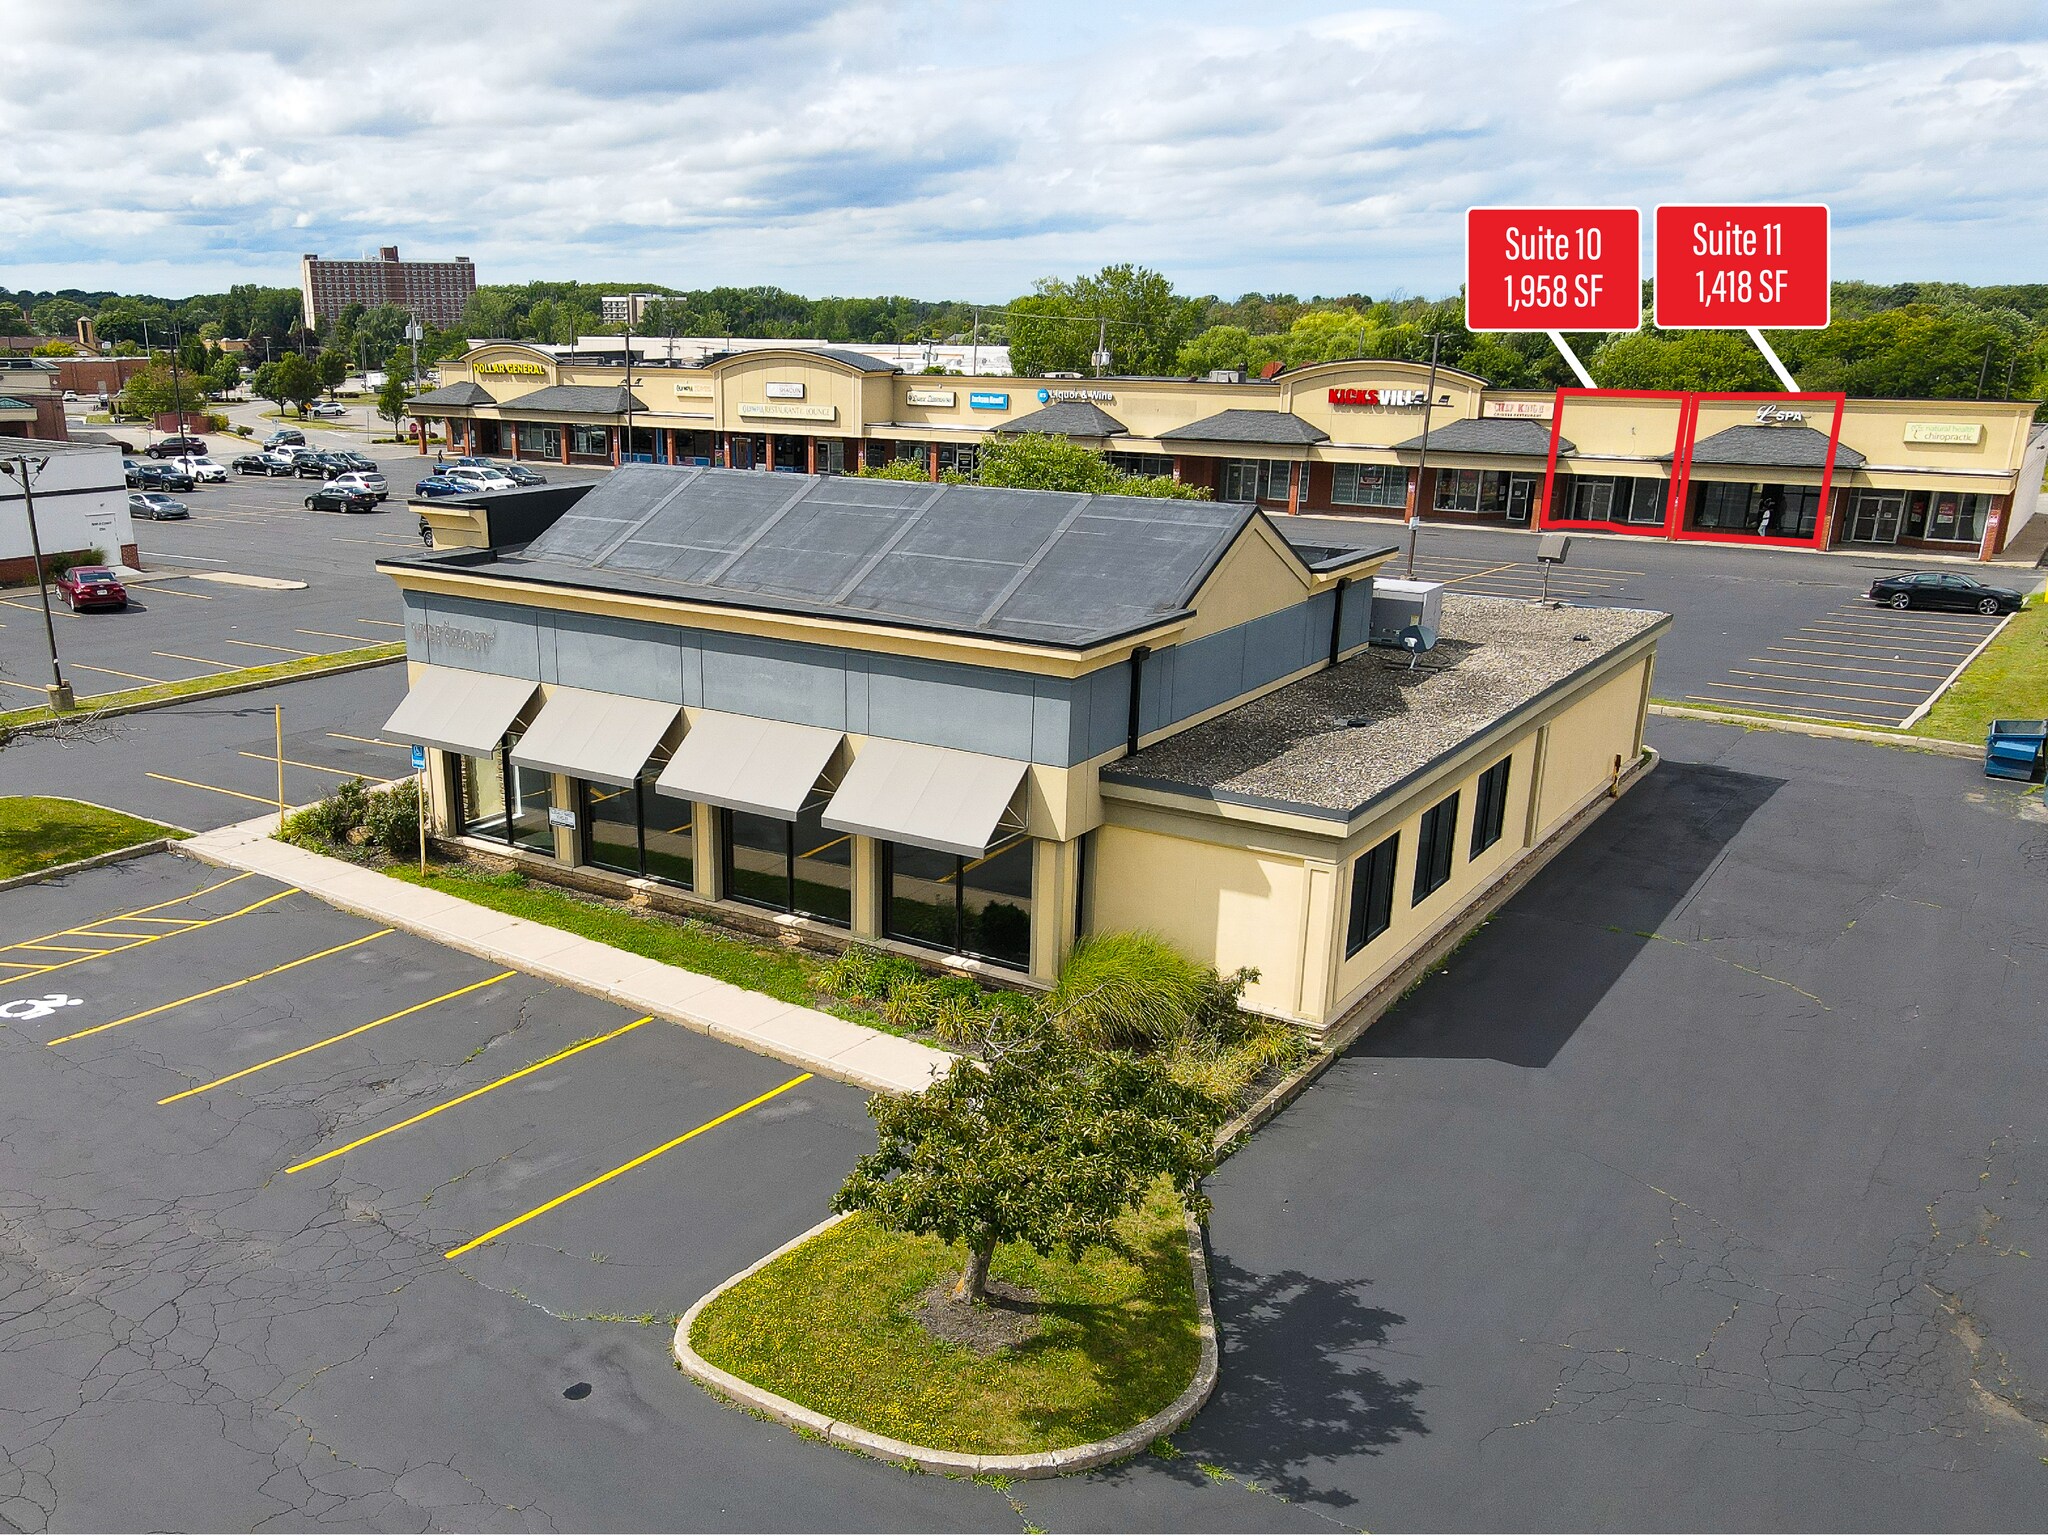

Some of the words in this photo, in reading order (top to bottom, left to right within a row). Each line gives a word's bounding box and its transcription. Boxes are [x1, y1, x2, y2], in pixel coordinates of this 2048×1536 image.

[473, 363, 506, 373] DOLLAR
[506, 363, 545, 375] GENERAL
[1049, 389, 1078, 401] Liquor
[1081, 390, 1088, 399] &
[1089, 391, 1114, 401] Wine
[1776, 410, 1803, 421] SPA
[1925, 425, 1950, 433] natural
[1951, 425, 1976, 434] health
[1924, 432, 1974, 442] chiropractic
